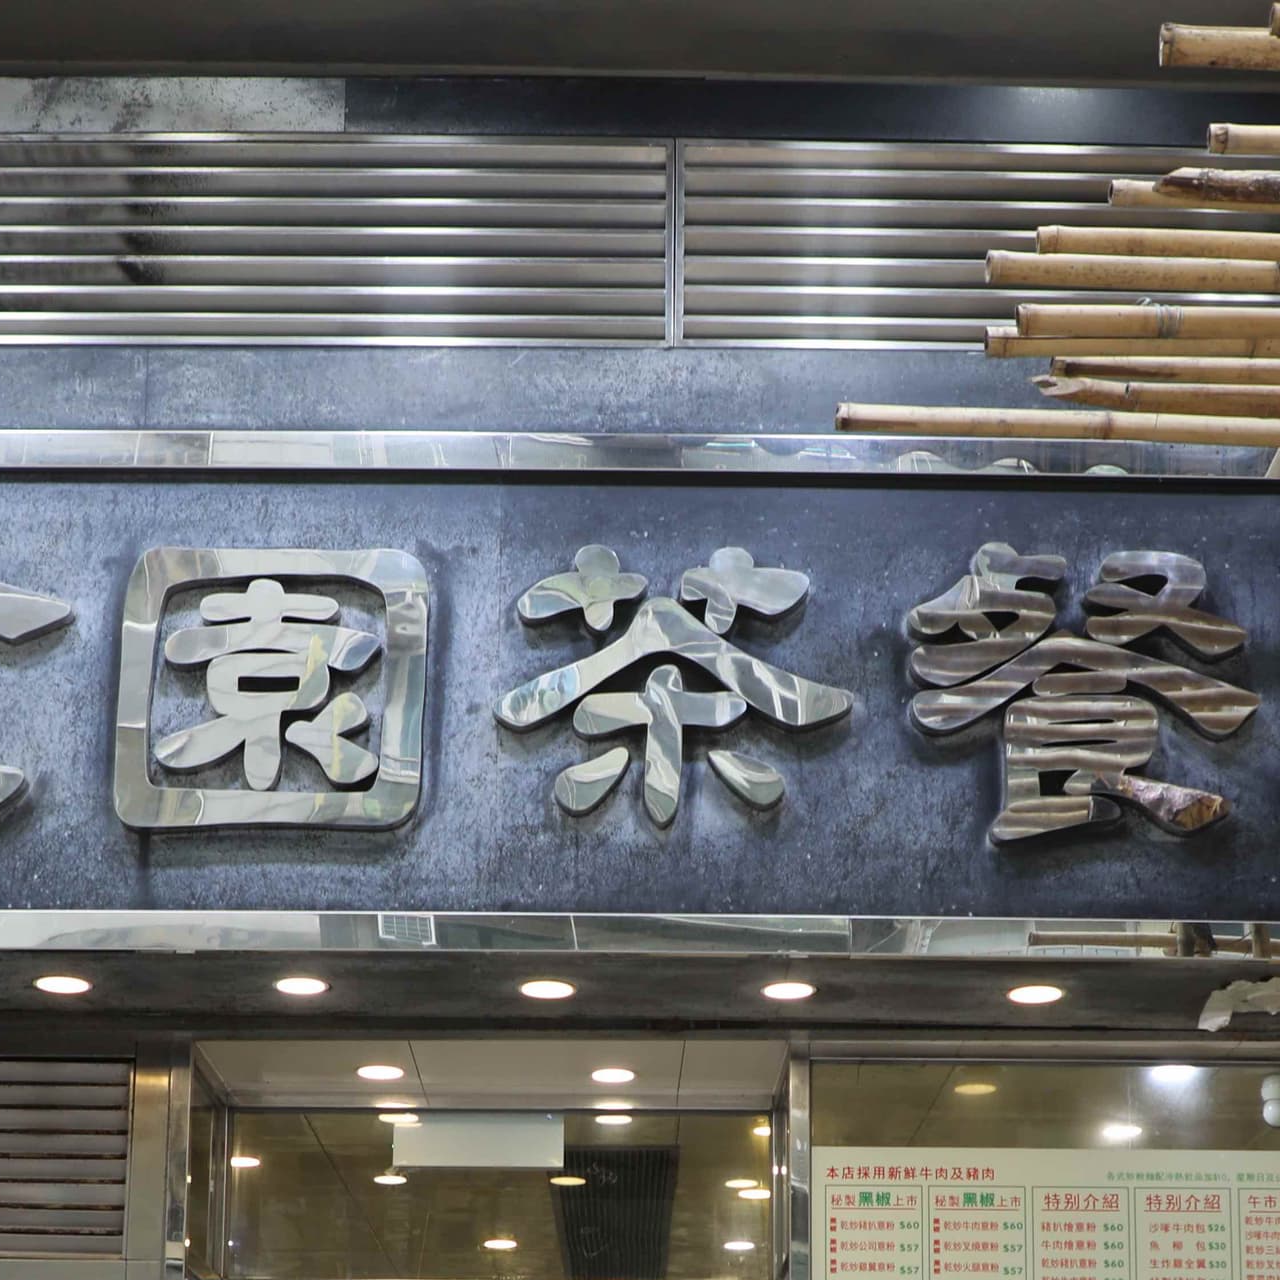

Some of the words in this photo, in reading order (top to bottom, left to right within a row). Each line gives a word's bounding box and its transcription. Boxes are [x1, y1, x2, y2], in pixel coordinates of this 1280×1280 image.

[826, 1165, 995, 1181] 本店採用新鮮牛肉及豬肉
